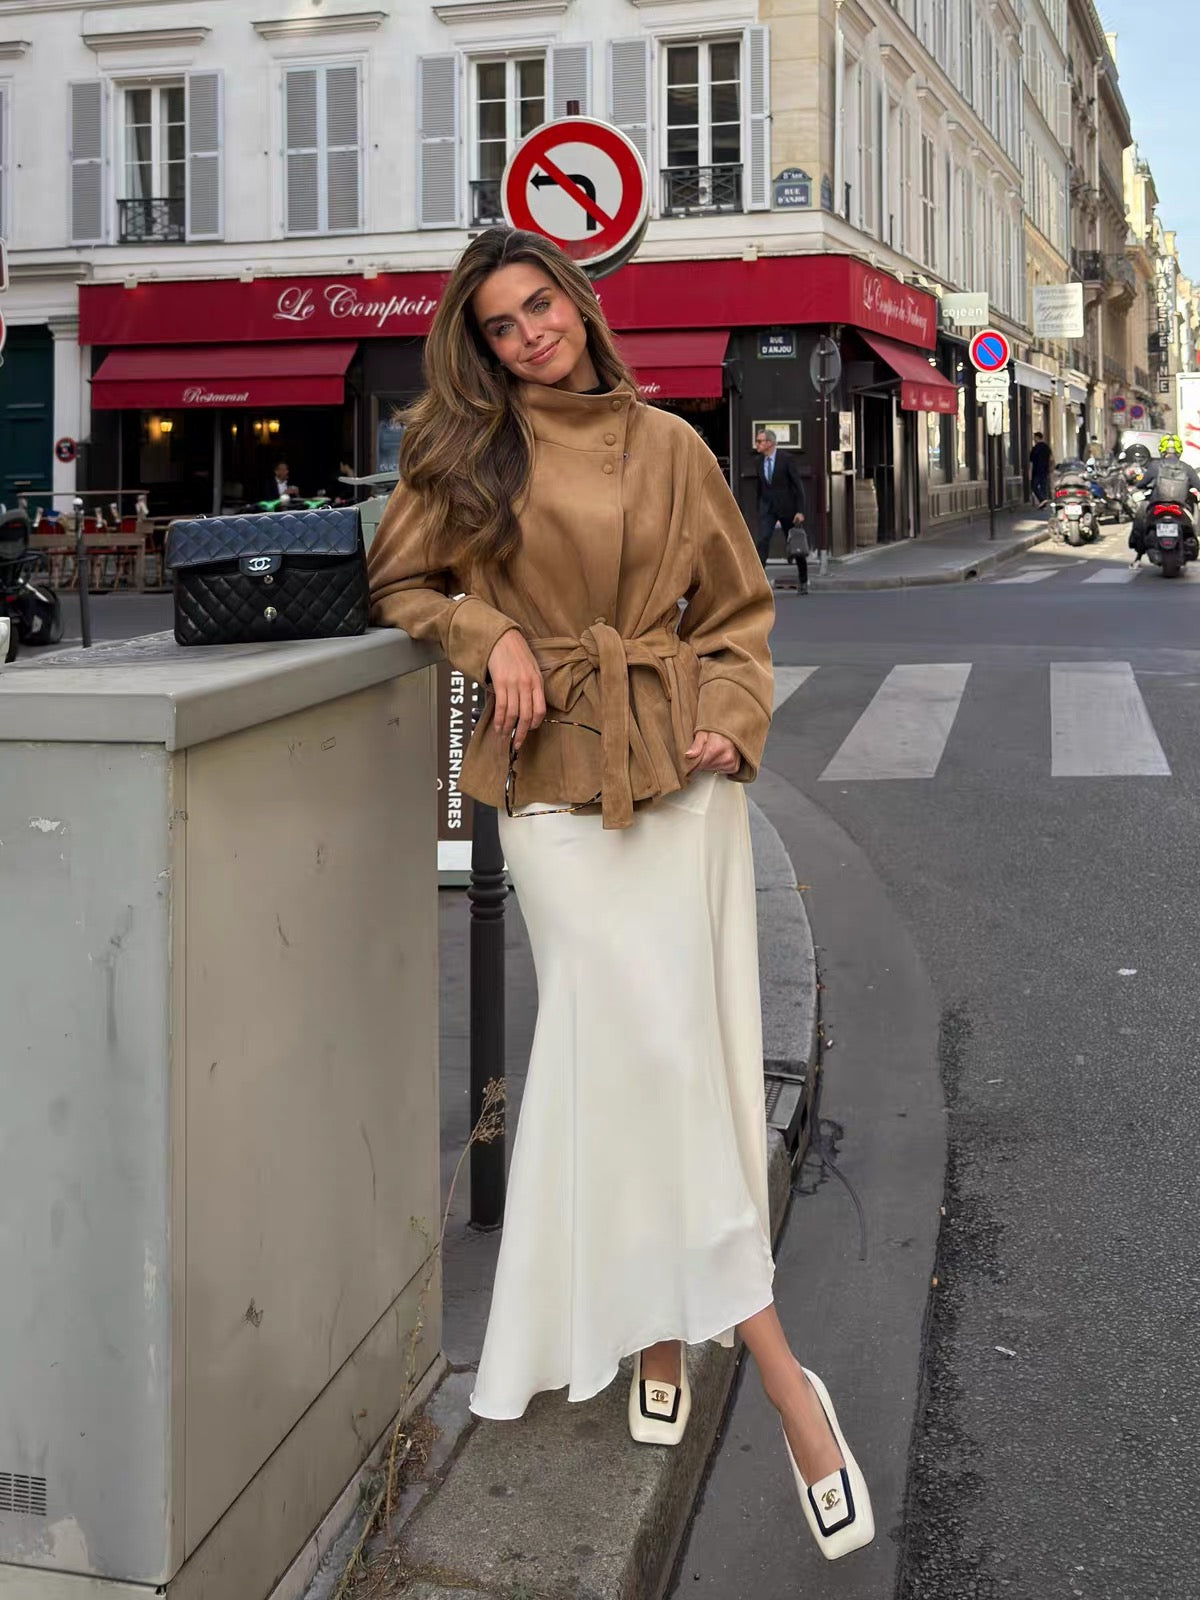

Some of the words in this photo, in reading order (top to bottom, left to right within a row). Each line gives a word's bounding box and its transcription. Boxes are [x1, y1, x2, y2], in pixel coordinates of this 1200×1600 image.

[784, 188, 800, 196] RUE
[778, 196, 806, 204] D'ANJOU
[273, 286, 315, 321] Le
[324, 284, 437, 328] Comptoir
[942, 306, 983, 319] cojean
[769, 336, 784, 344] RUE
[762, 346, 792, 354] D'ANJOU
[638, 382, 660, 393] erie
[182, 386, 250, 403] Restaurant
